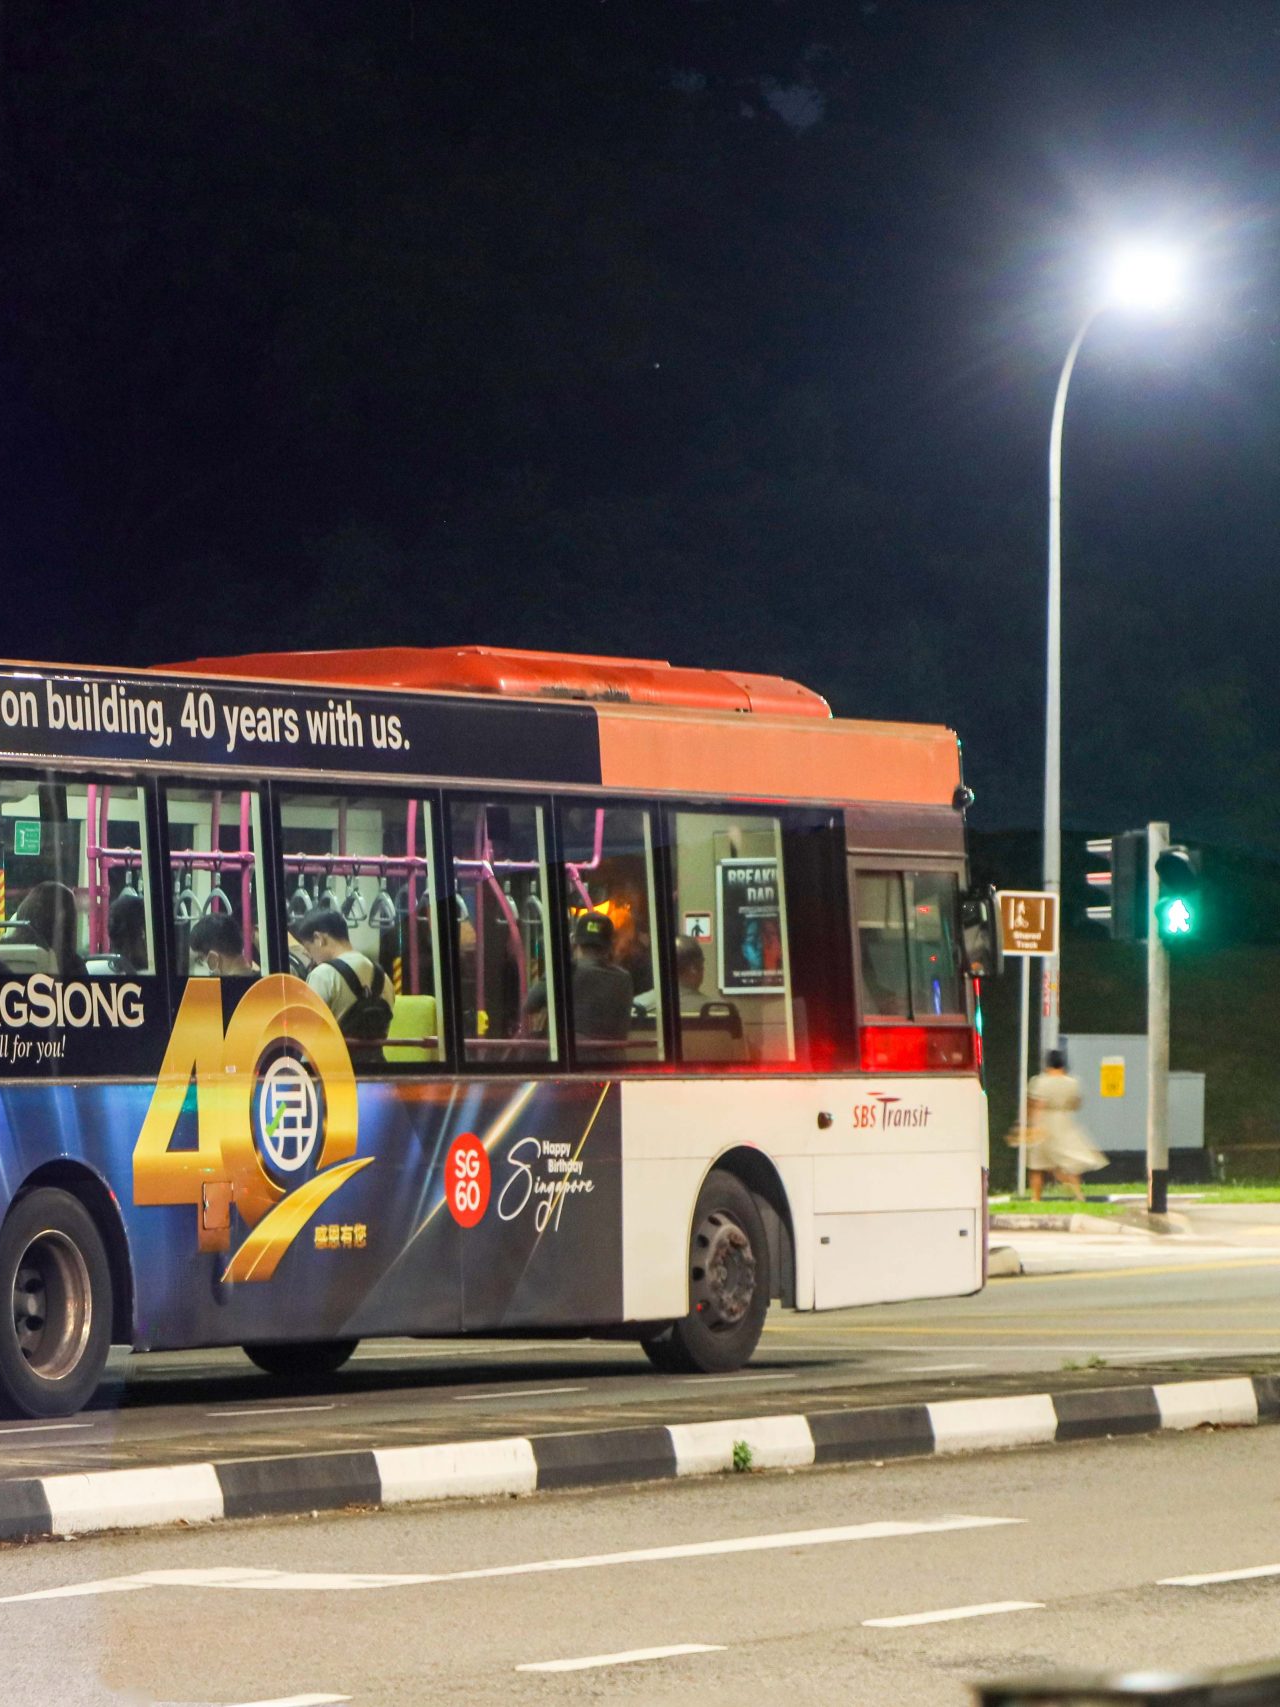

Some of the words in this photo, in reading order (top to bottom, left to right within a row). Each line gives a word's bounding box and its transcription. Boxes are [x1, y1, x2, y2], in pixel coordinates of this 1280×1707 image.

[46, 679, 173, 748] building,
[180, 692, 216, 739] 40
[223, 703, 300, 753] years
[306, 699, 364, 748] with
[370, 712, 411, 751] us.
[9, 1034, 33, 1064] for
[36, 1035, 66, 1064] you!
[133, 973, 358, 1252] 40
[853, 1105, 877, 1128] SBS
[876, 1097, 932, 1132] Transit
[455, 1149, 480, 1178] SG
[542, 1141, 572, 1157] Happy
[548, 1159, 584, 1175] Birthday
[455, 1180, 481, 1211] 60
[498, 1137, 595, 1232] Singapore
